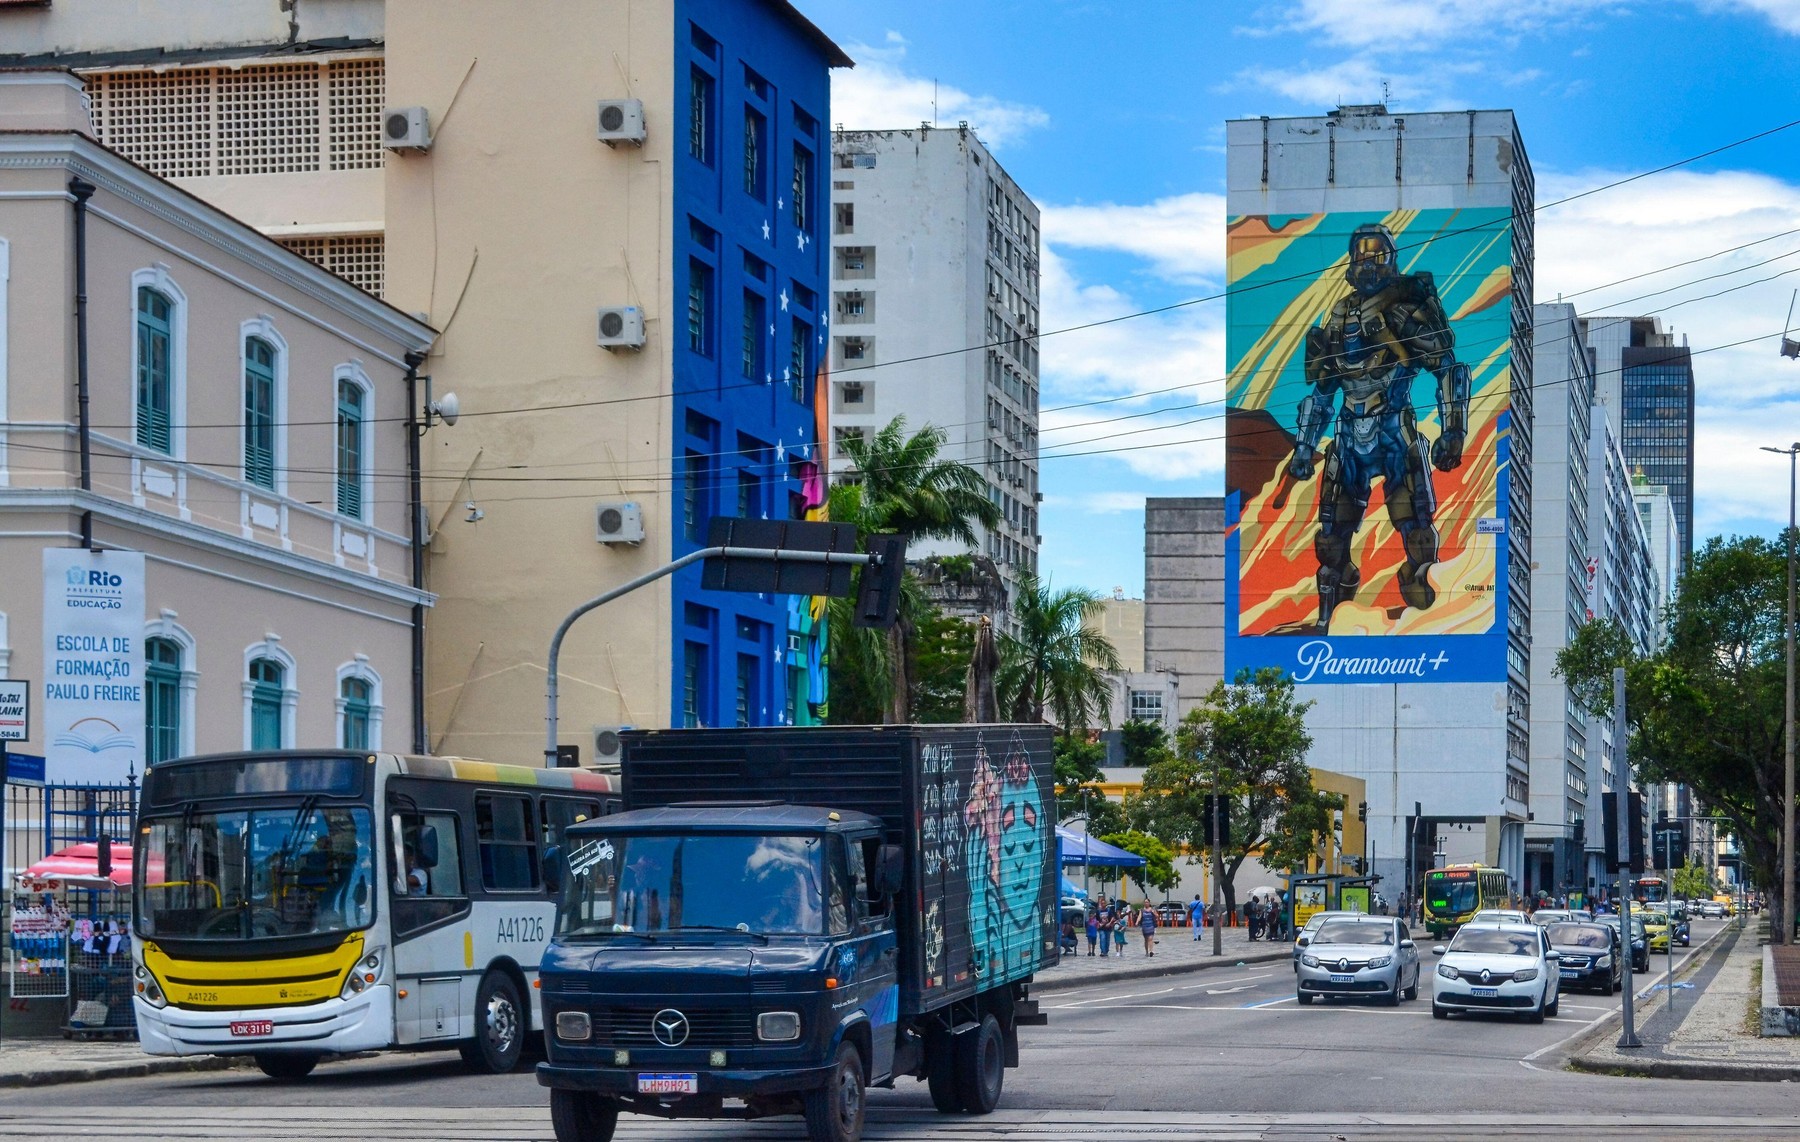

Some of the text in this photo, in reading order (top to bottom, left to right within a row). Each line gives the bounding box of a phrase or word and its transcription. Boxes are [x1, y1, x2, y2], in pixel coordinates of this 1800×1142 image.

[89, 569, 122, 586] Rio
[67, 599, 122, 610] EDUCAÇÃO
[56, 635, 130, 653] ESCOLA DE
[56, 658, 130, 681] FORMAÇÃO
[1292, 640, 1449, 682] Paramount+
[46, 683, 141, 702] PAULO FREIRE
[497, 916, 544, 943] A41226
[187, 992, 218, 1002] A41226
